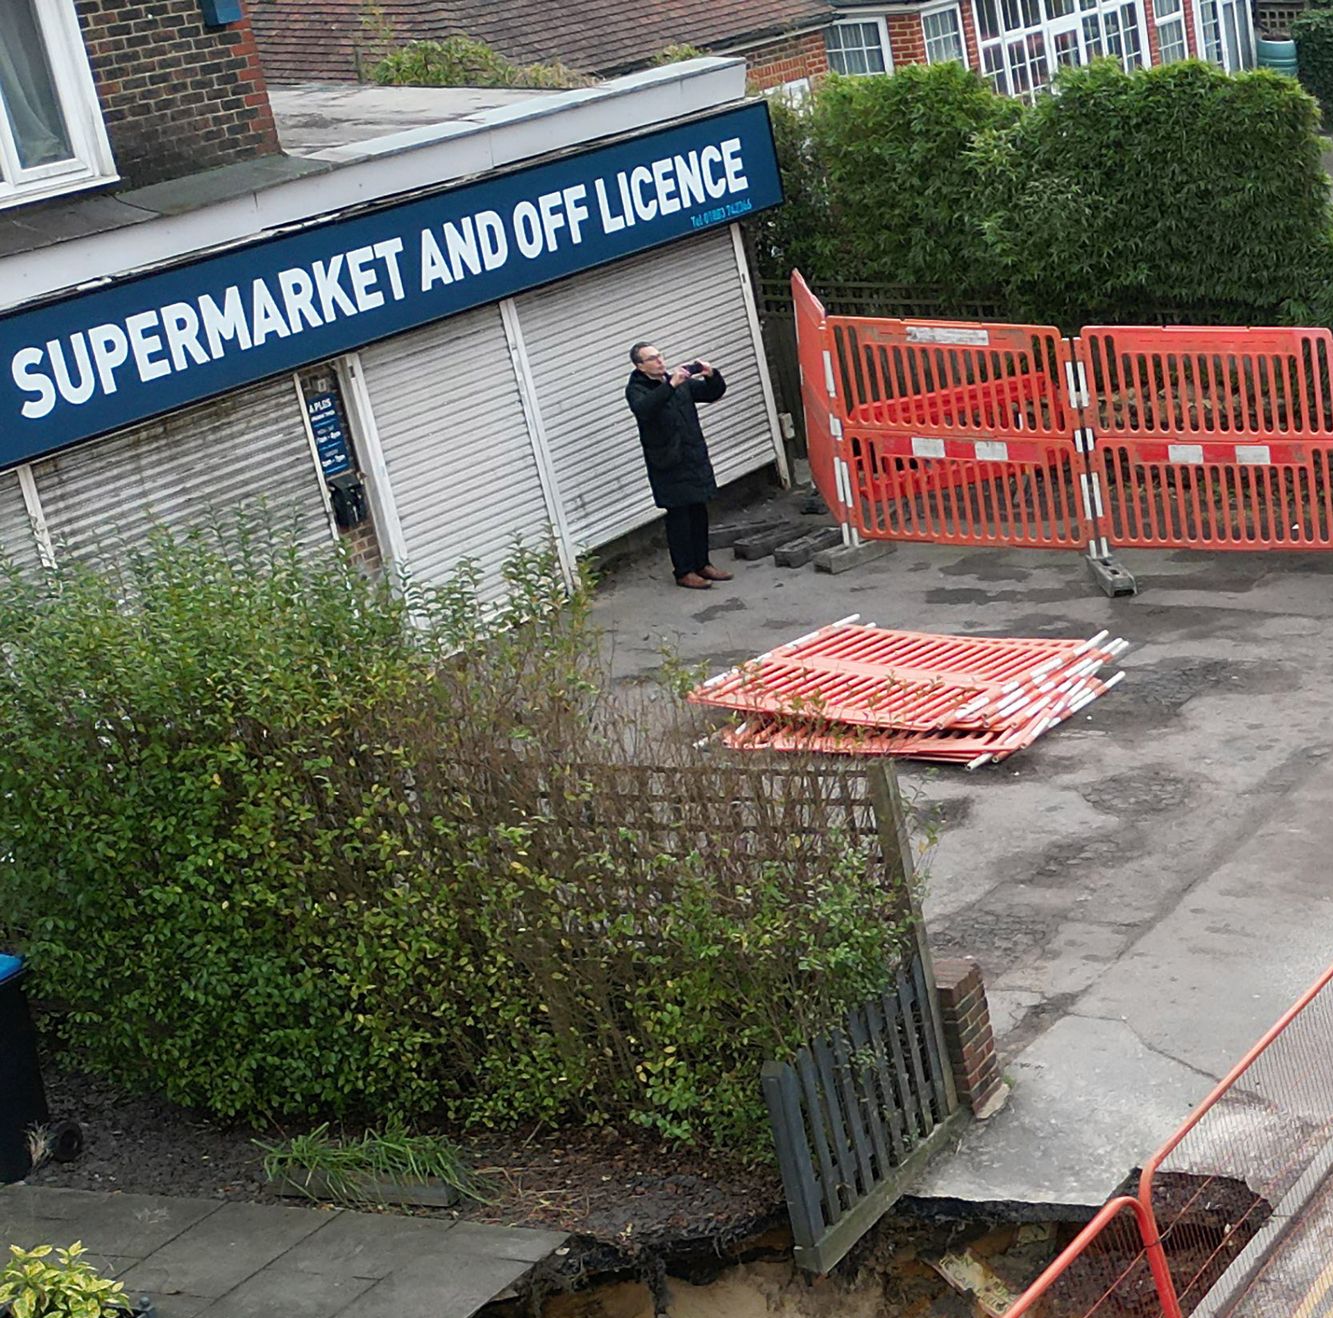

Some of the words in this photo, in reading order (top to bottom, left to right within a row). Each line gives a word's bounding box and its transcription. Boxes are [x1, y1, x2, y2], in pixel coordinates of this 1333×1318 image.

[11, 236, 406, 420] SUPERMARKET
[420, 210, 509, 293] AND
[512, 184, 590, 261] OFF
[594, 137, 749, 235] LICENCE
